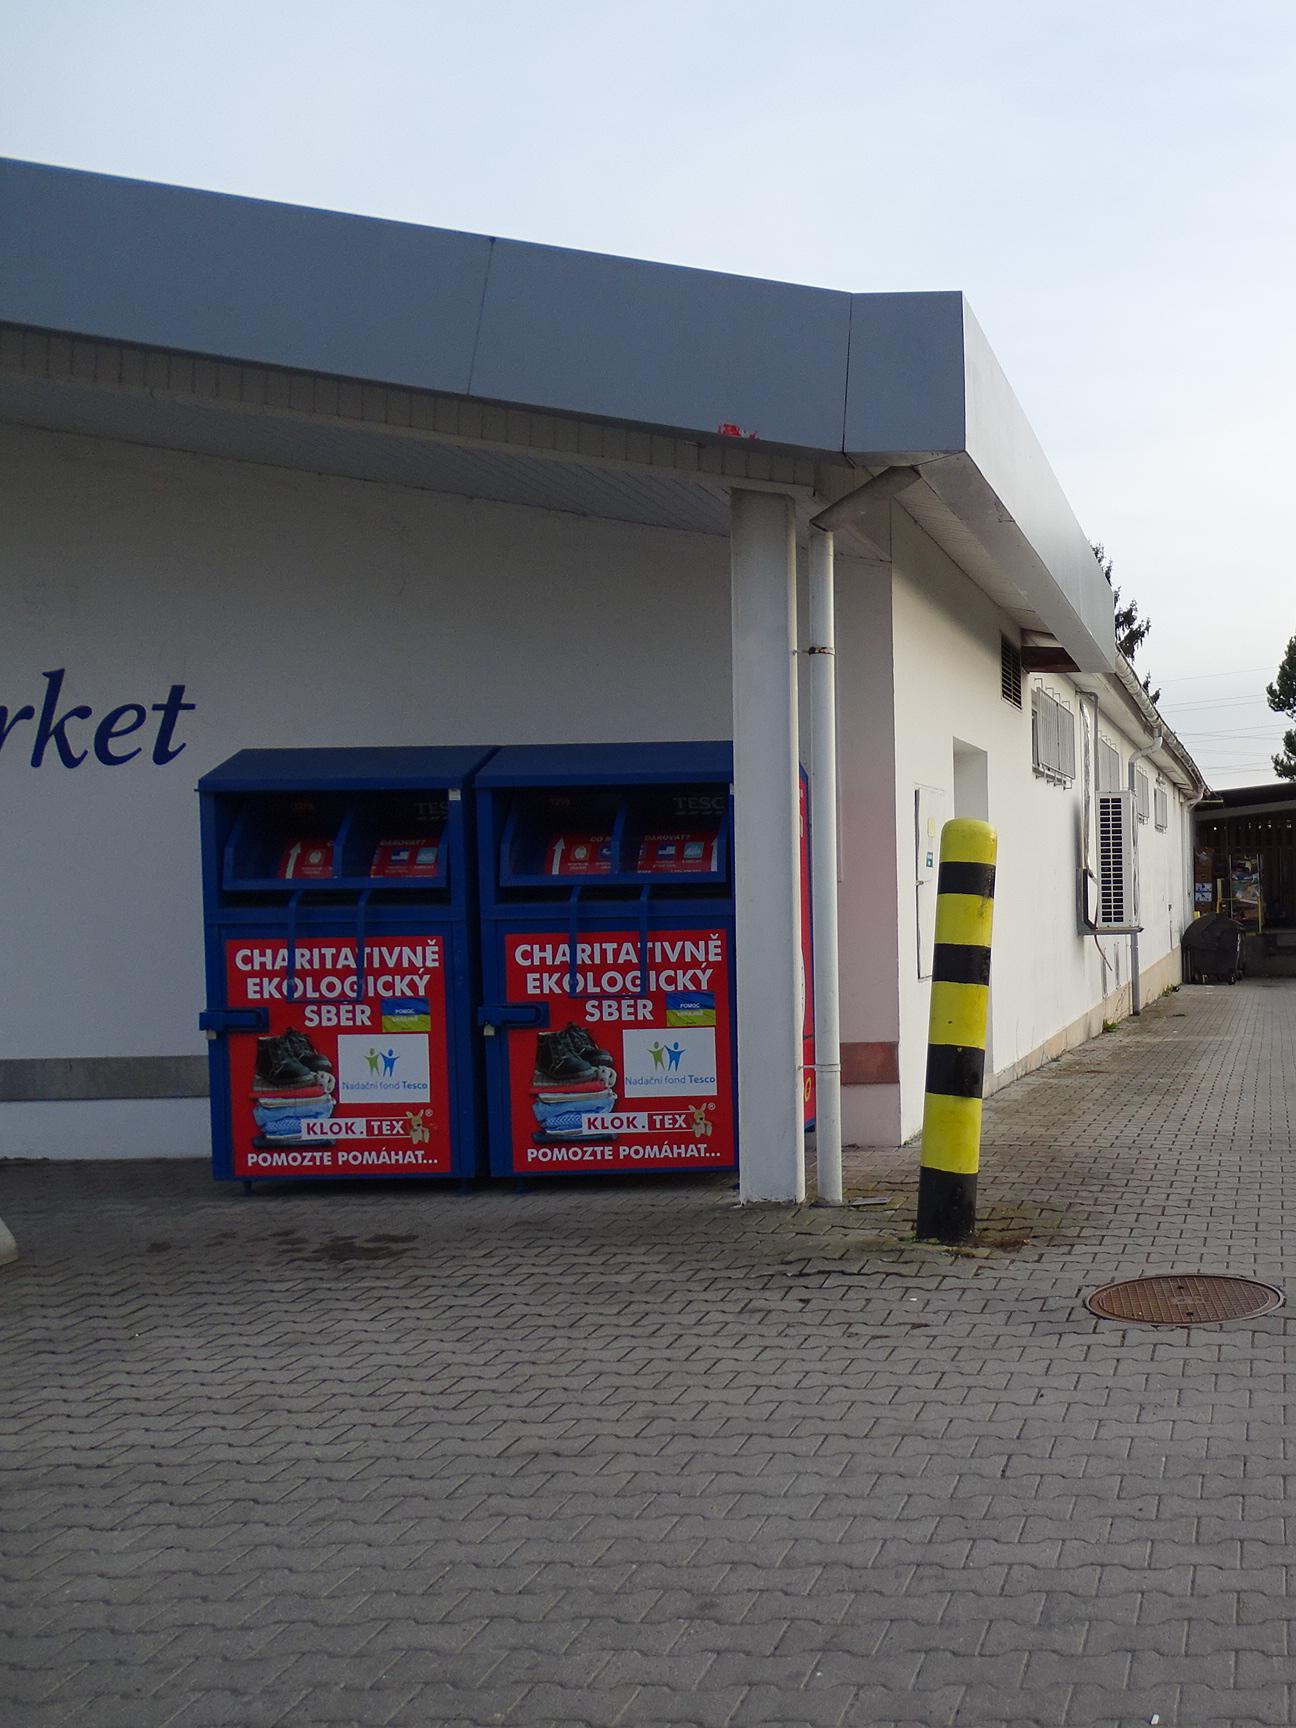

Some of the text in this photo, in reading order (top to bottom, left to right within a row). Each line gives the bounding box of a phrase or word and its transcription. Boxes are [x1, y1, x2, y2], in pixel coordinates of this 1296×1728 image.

[247, 968, 431, 999] EKOLOGICKÝ
[526, 962, 713, 994] EKOLOGICKÝ
[585, 993, 654, 1022] SBĚR
[379, 1080, 400, 1090] fond
[402, 1080, 428, 1089] Tesco
[664, 1075, 686, 1084] fond
[688, 1074, 716, 1084] Tesco
[247, 1147, 438, 1167] POMOZTE POMÁHAT...
[526, 1140, 721, 1162] POMOZTE POMÁHAT...
